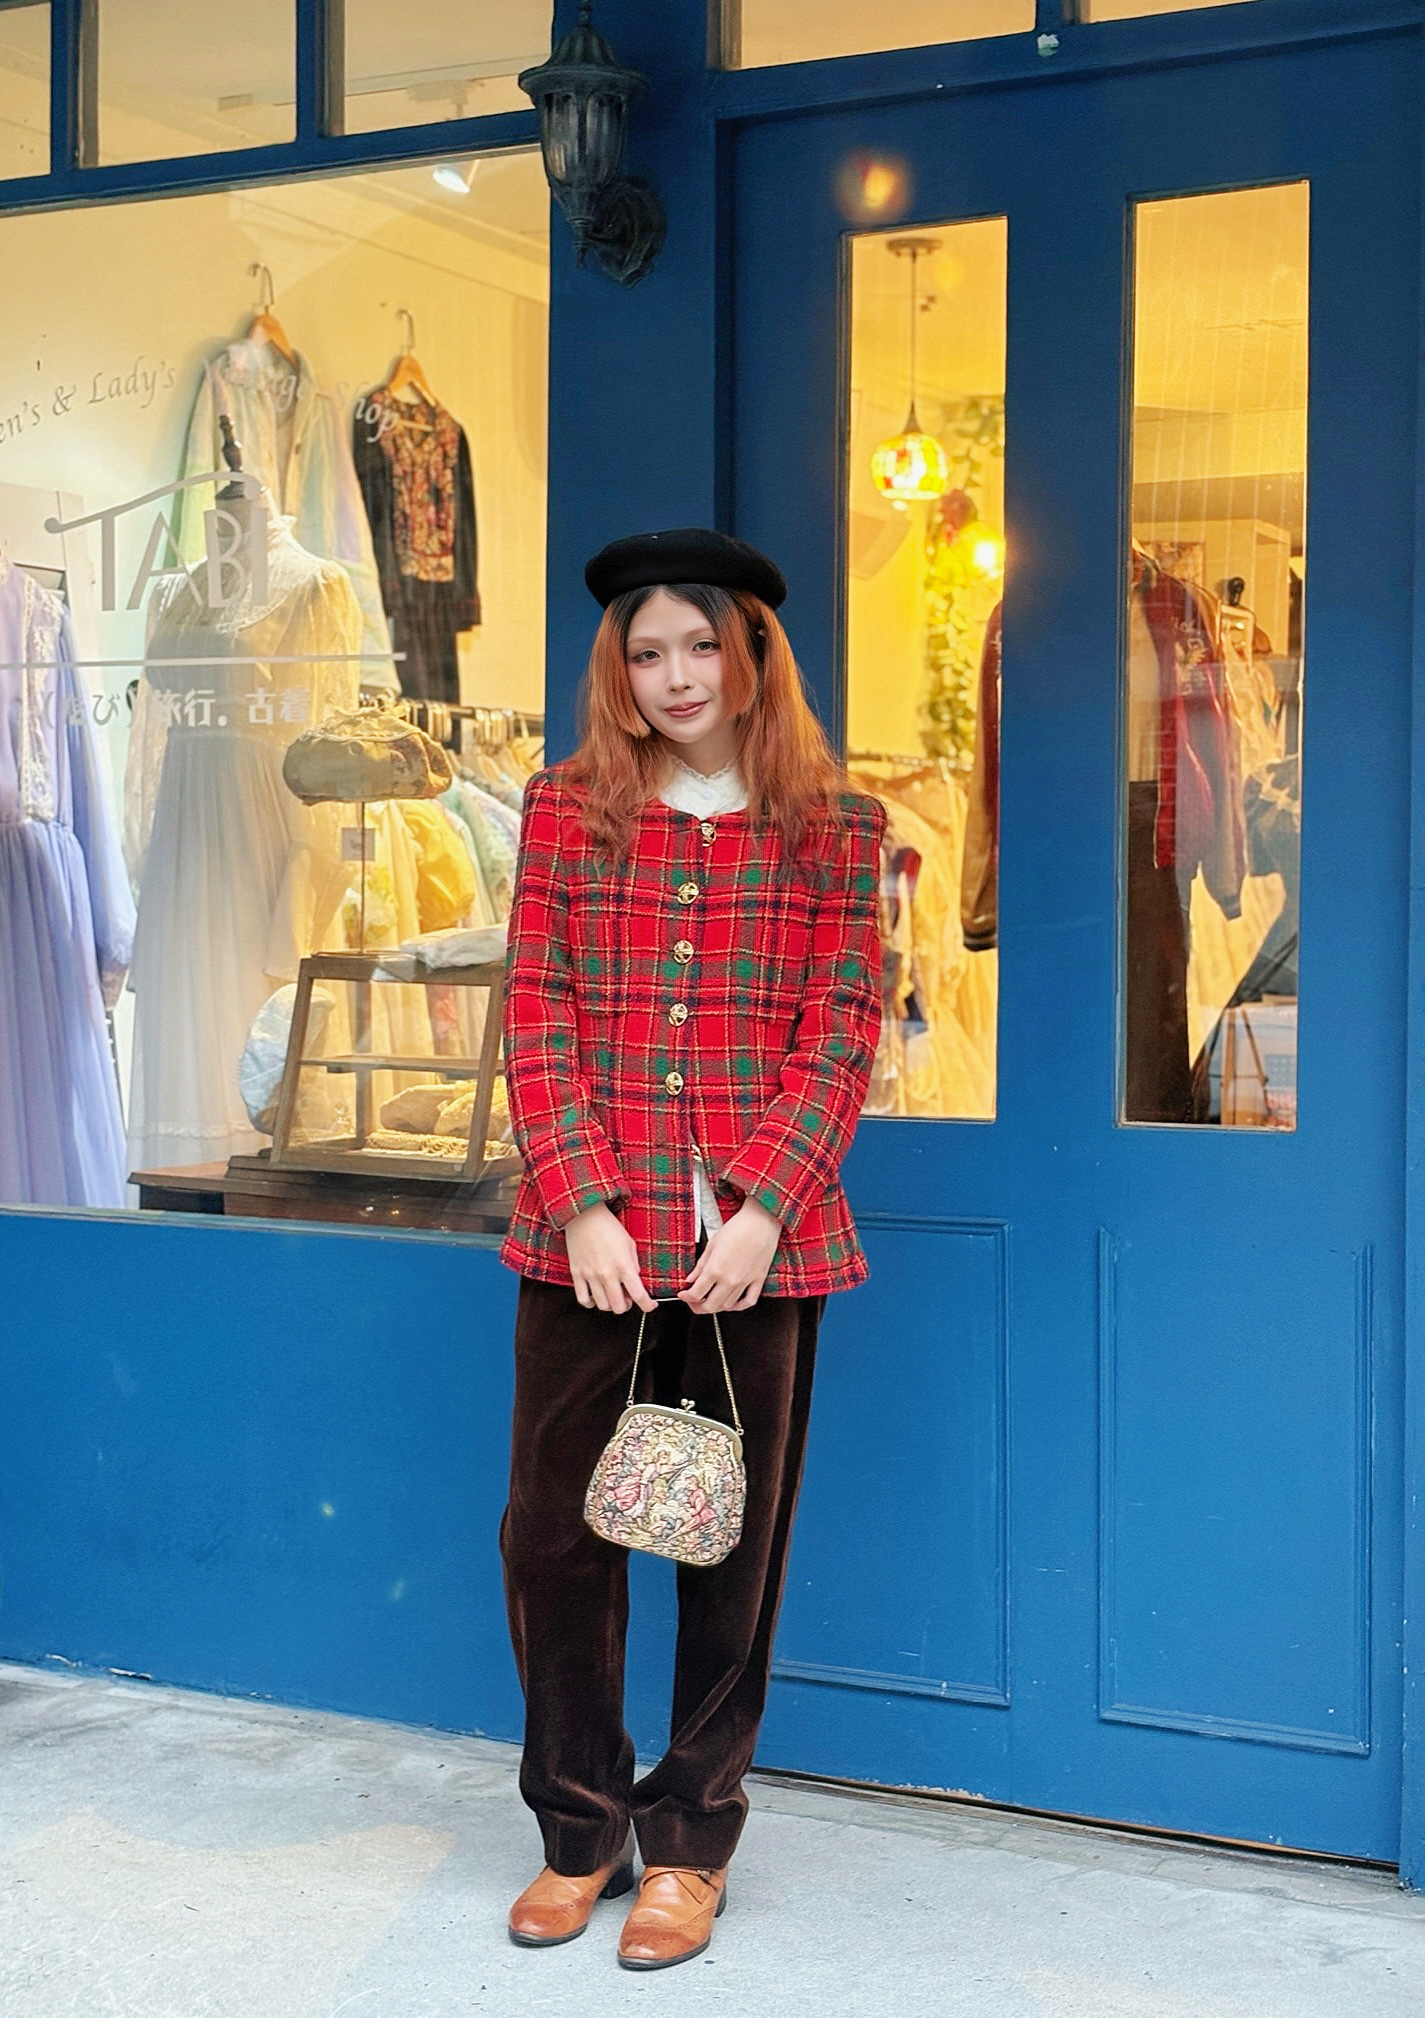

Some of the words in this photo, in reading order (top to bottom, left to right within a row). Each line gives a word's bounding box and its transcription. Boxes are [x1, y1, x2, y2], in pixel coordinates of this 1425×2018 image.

[52, 385, 77, 416] &
[87, 355, 176, 409] Lady's
[44, 471, 269, 612] TABI
